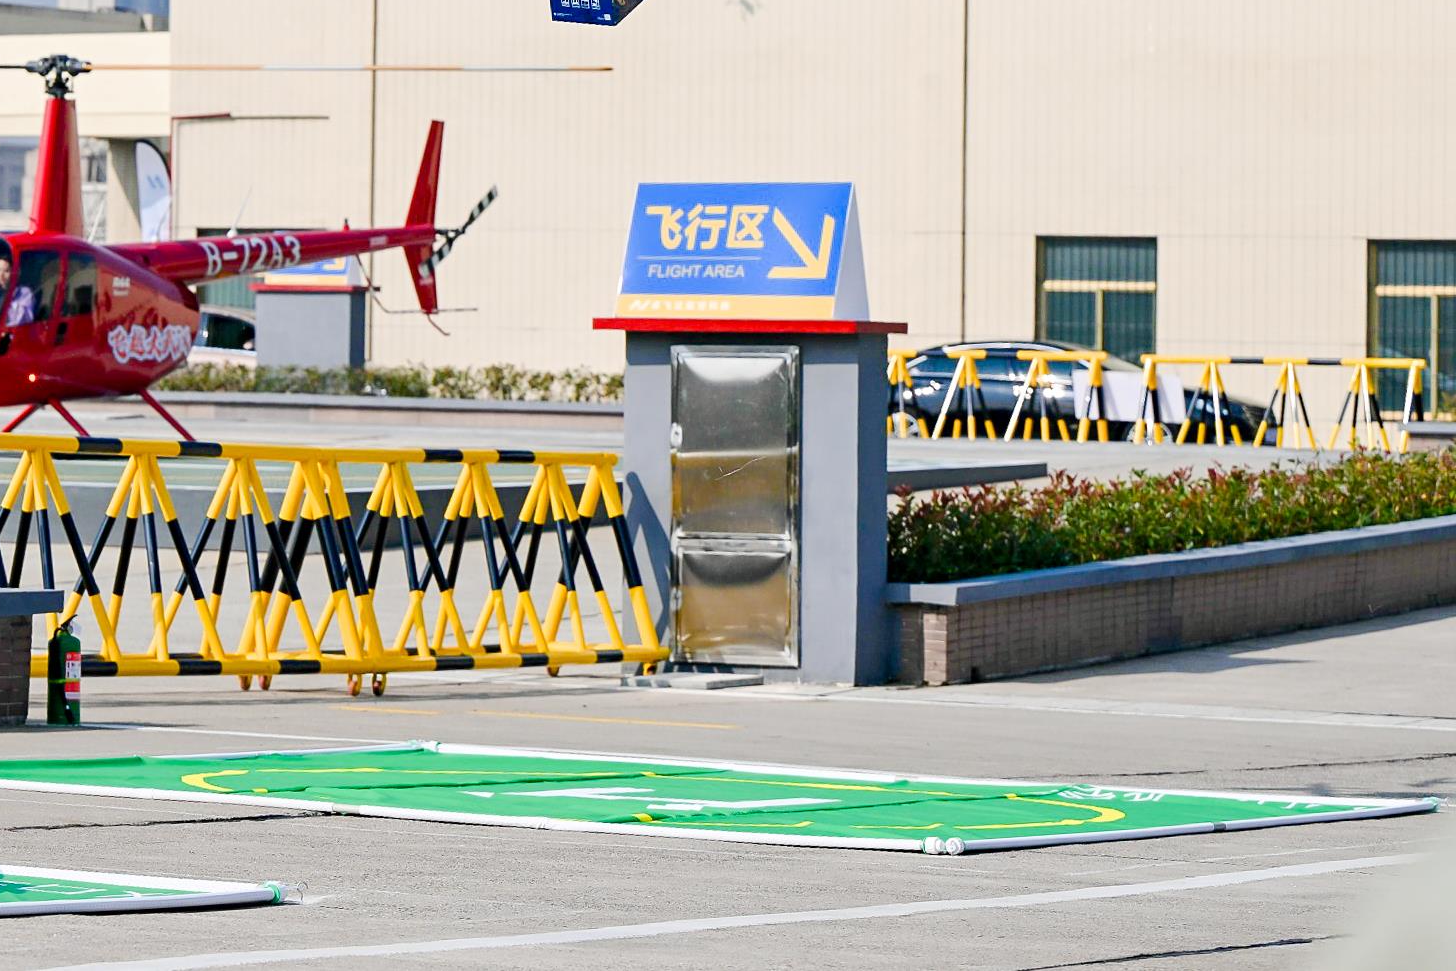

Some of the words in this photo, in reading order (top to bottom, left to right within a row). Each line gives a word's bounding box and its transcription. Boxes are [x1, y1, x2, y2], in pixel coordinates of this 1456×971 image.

[645, 203, 769, 251] 飞行区
[198, 235, 301, 277] B-72A3
[647, 264, 701, 279] FLIGHT
[703, 264, 745, 279] AREA
